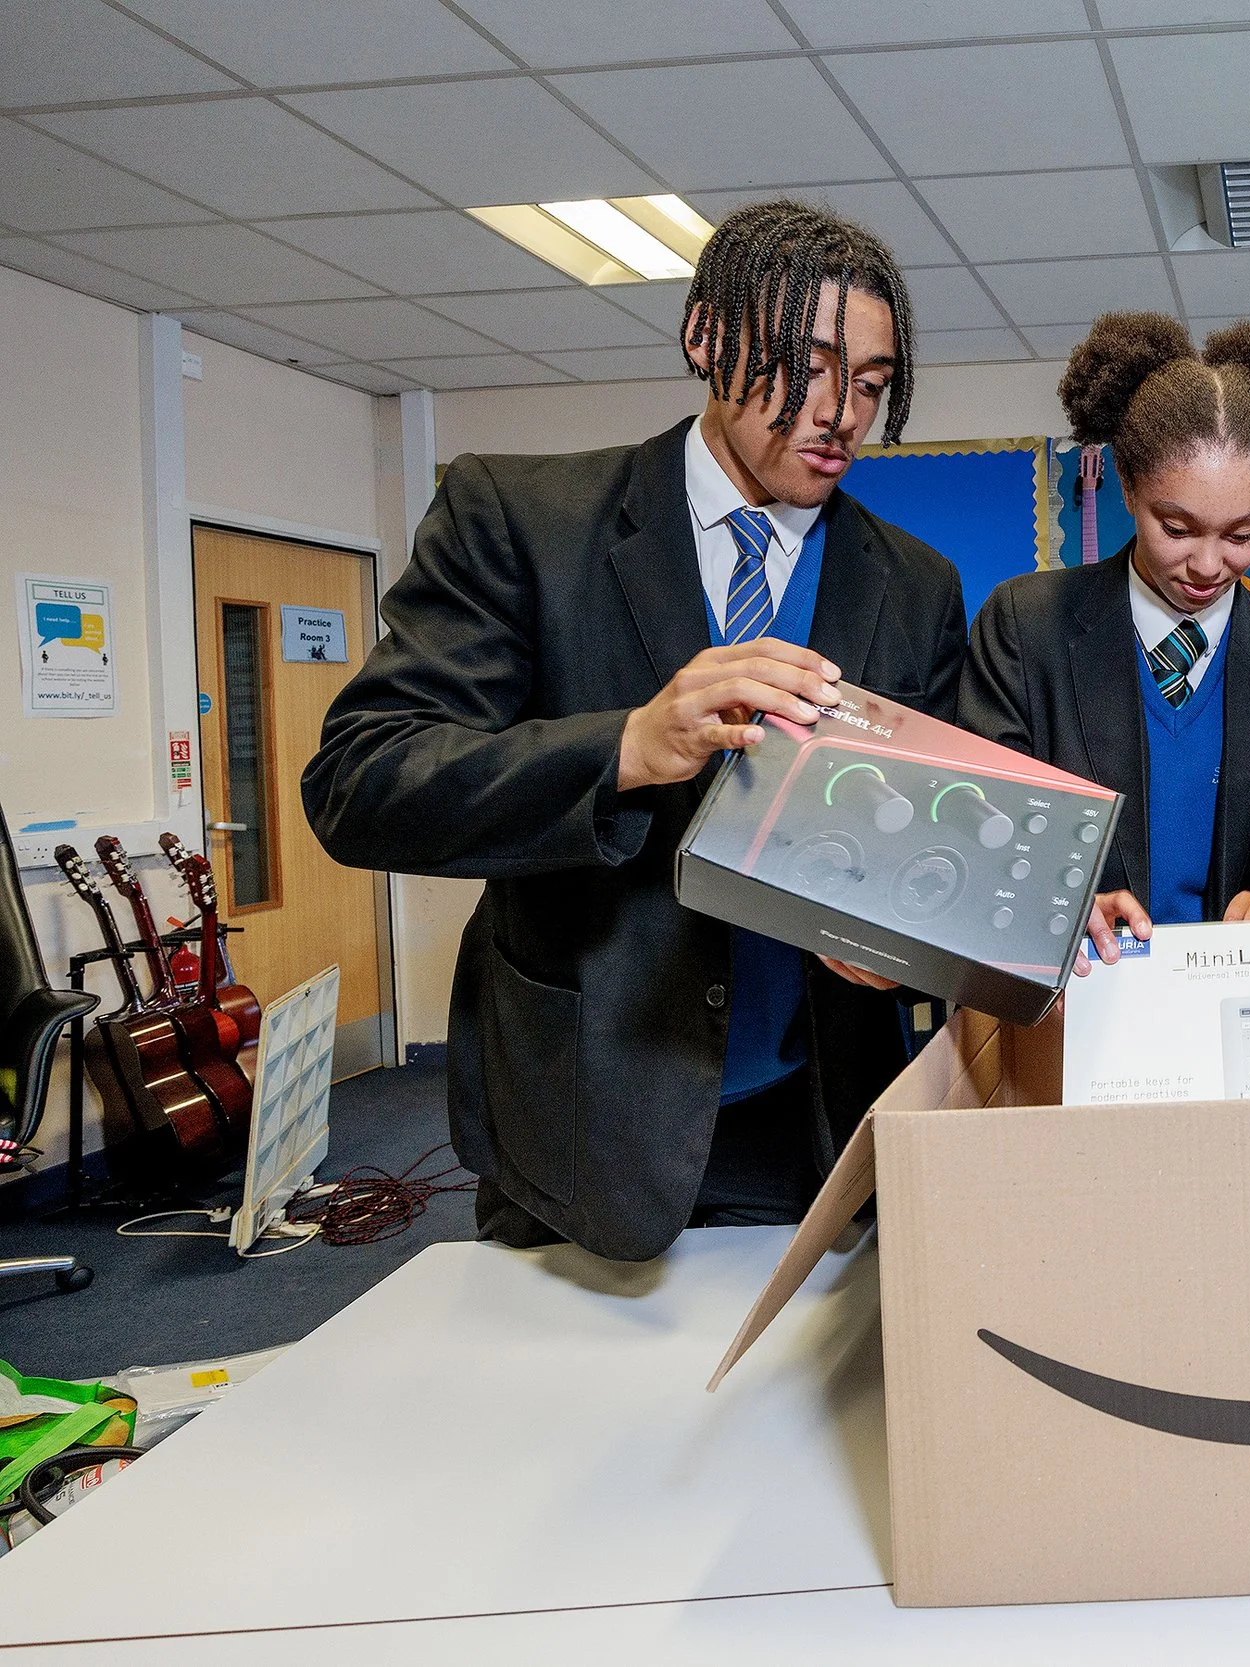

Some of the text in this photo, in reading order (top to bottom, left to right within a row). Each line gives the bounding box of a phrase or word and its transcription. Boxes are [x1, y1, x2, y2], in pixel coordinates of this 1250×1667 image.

[53, 590, 87, 600] TELL US
[298, 617, 332, 628] Practice
[300, 633, 331, 642] Room 3
[38, 691, 112, 701] www.bit.ly/_tell_us
[871, 724, 894, 740] 4i4
[929, 779, 937, 789] 2
[1027, 797, 1052, 809] Select
[1083, 807, 1100, 817] 48V
[1014, 843, 1031, 853] Inst
[1069, 851, 1083, 861] Air
[994, 887, 1015, 899] Auto
[1051, 895, 1070, 908] Safe
[1118, 941, 1145, 951] URIA
[1187, 971, 1231, 982] Universal
[1091, 1075, 1194, 1091] Portable keys for
[1090, 1089, 1190, 1104] modern creatives
